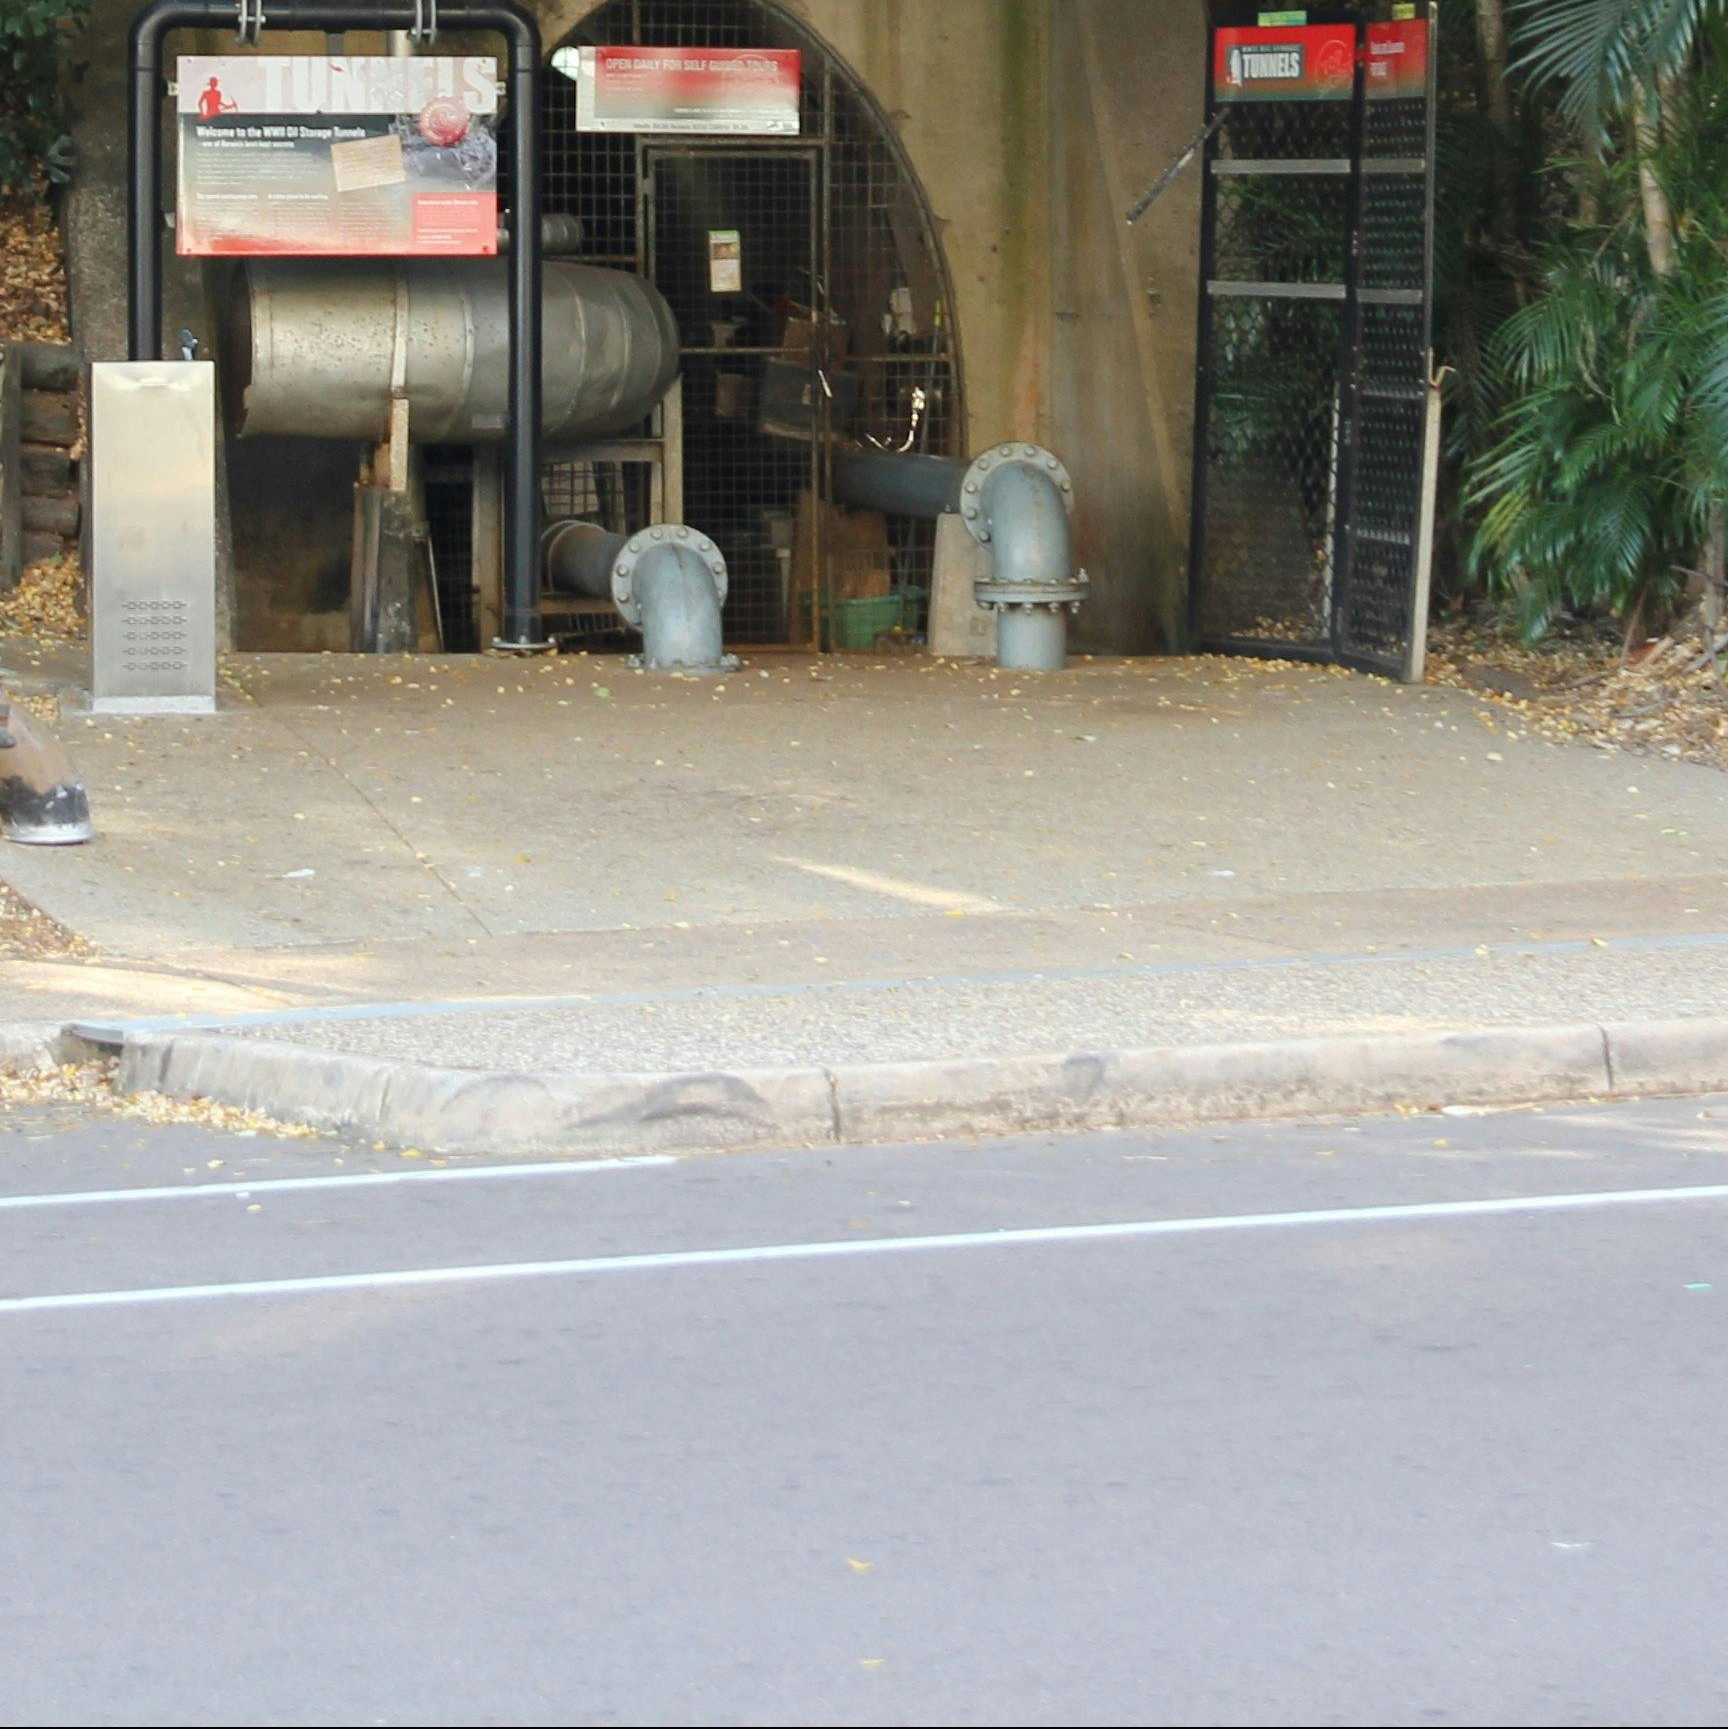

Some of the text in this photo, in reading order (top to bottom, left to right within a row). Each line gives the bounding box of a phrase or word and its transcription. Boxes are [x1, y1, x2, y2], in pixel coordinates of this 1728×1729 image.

[606, 59, 631, 69] OPEN
[634, 59, 659, 70] DAILY
[663, 59, 682, 70] FOR
[684, 60, 706, 70] SELF
[1243, 52, 1300, 78] TUNNELS
